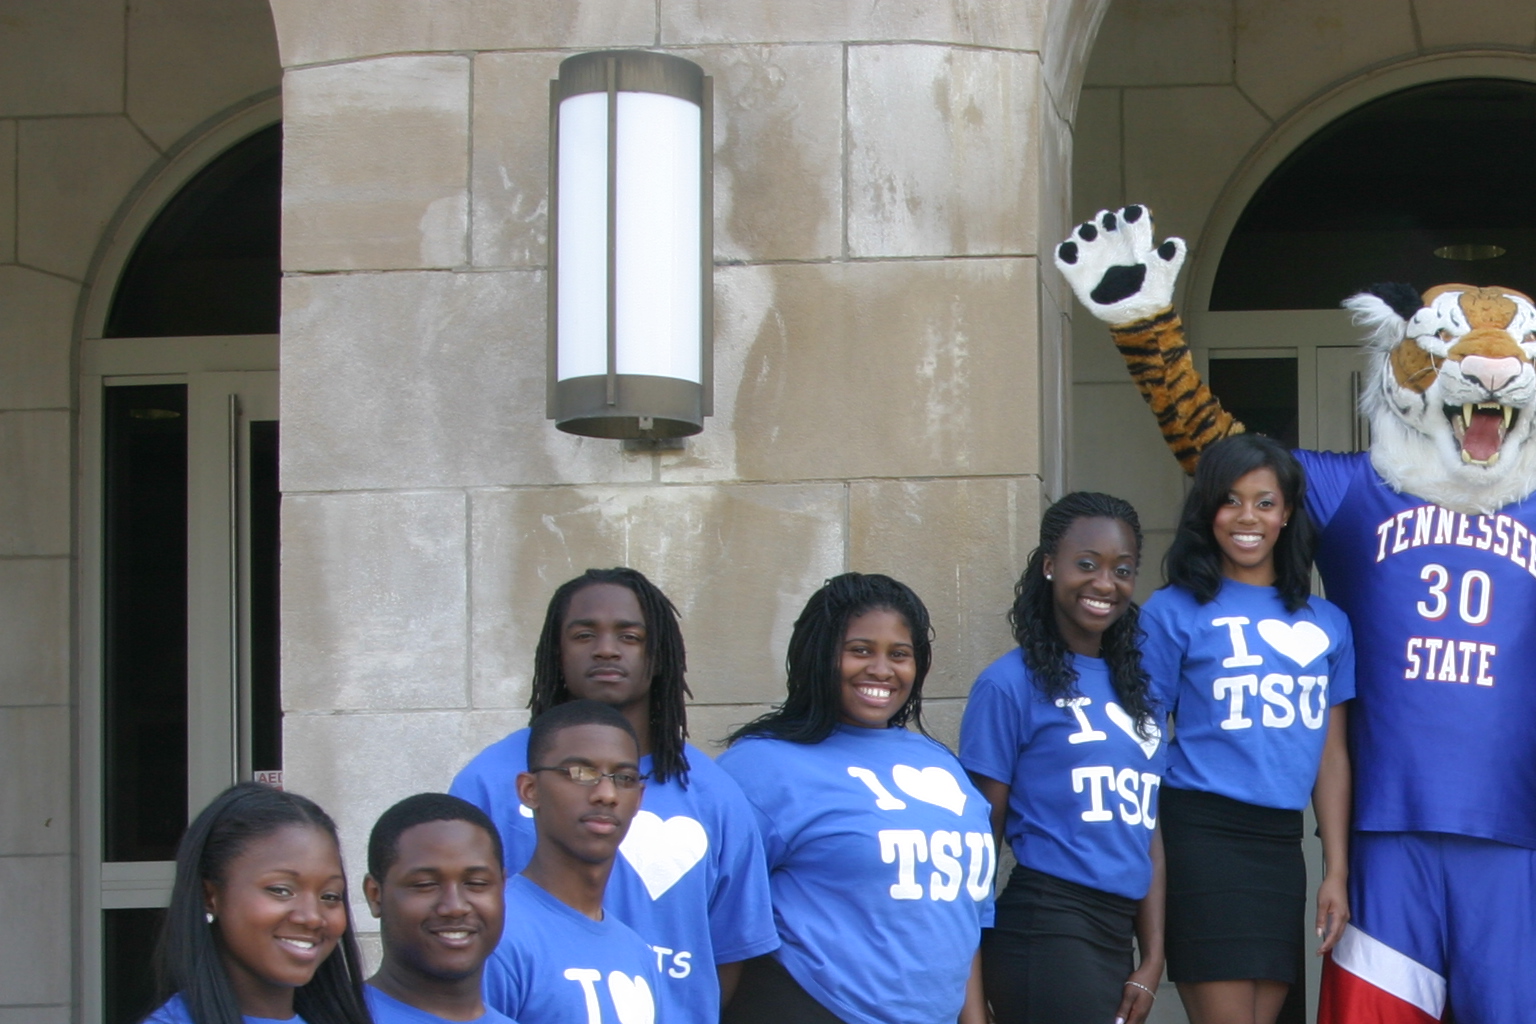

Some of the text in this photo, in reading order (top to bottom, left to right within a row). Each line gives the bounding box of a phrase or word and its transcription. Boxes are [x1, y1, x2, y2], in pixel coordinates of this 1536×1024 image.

[1417, 563, 1493, 626] 30
[1211, 616, 1263, 669] I
[1404, 637, 1496, 687] STATE
[1055, 696, 1107, 744] I
[1213, 673, 1328, 730] TSU
[847, 766, 907, 811] I
[878, 829, 996, 902] TSU
